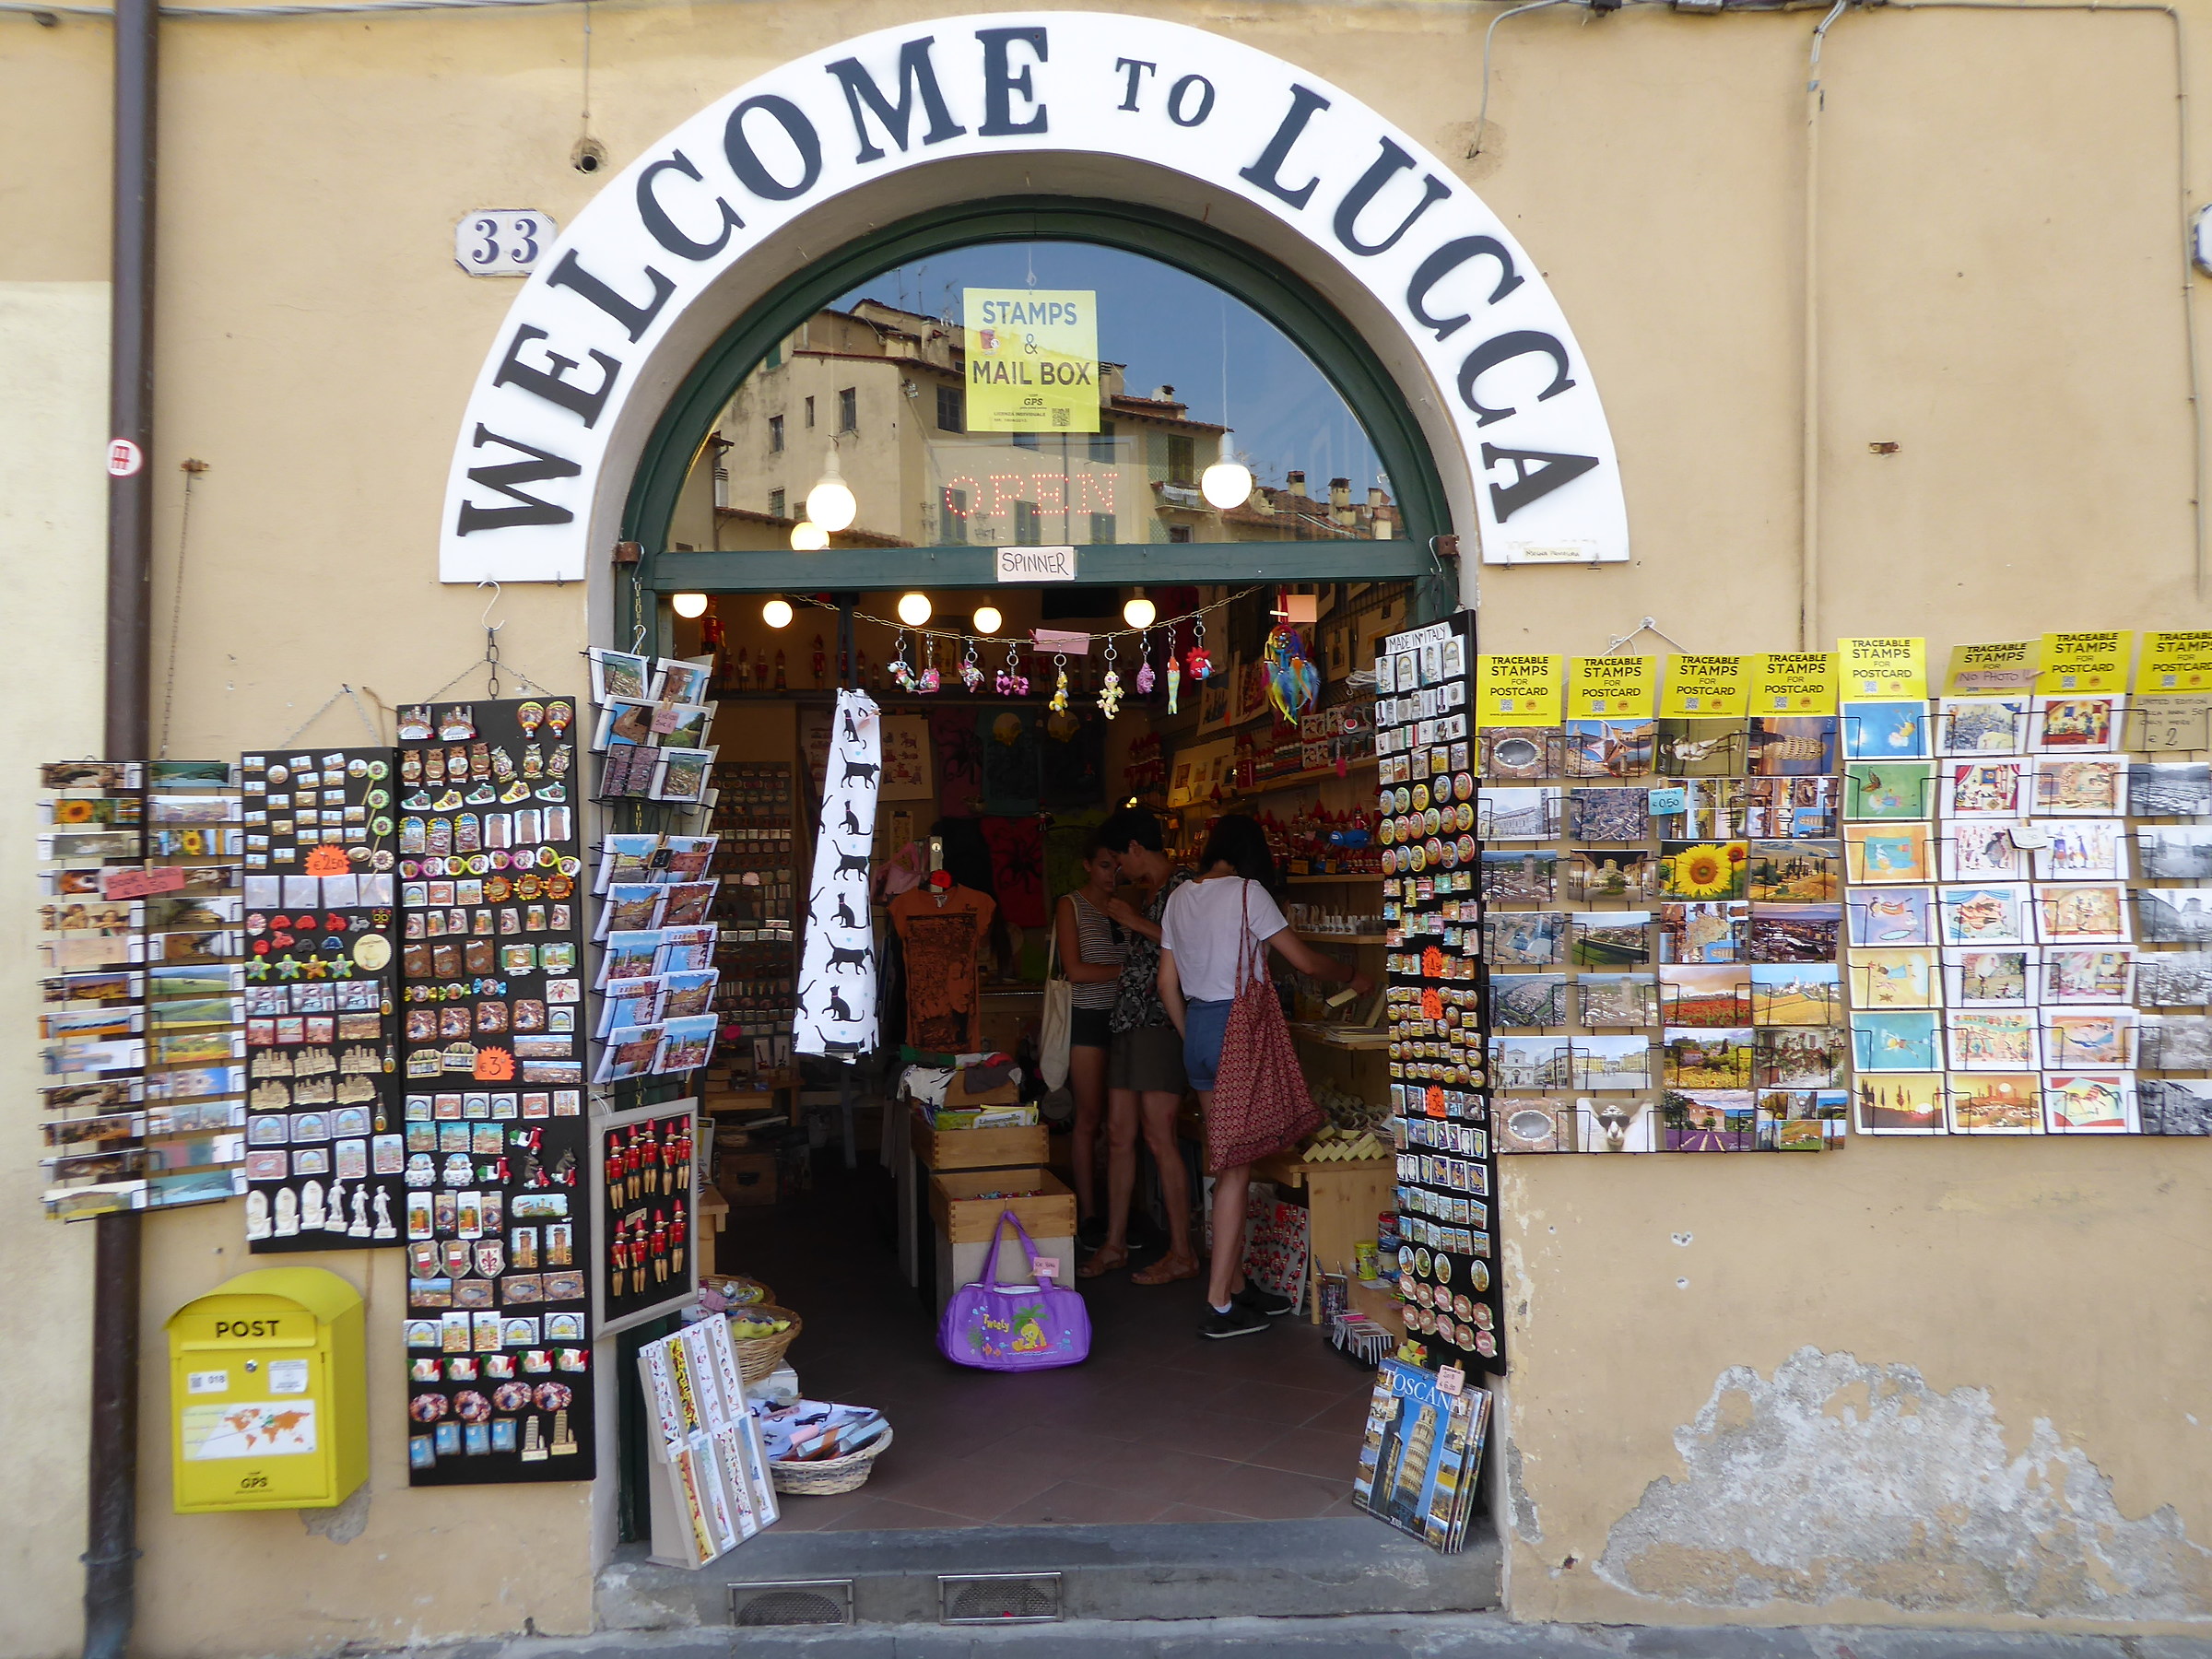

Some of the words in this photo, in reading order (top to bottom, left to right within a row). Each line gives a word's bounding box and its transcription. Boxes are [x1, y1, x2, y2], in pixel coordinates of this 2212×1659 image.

[472, 218, 538, 265] 33
[457, 26, 1048, 537] WELCOME
[1115, 57, 1215, 127] TO
[1239, 82, 1599, 524] LUCCA
[982, 300, 1077, 325] STAMPS
[1024, 333, 1039, 355] &
[973, 360, 1032, 385] MAIL
[1041, 362, 1091, 385] BOX
[1023, 397, 1043, 406] GPS
[946, 472, 1119, 517] OPEN
[1002, 551, 1069, 576] SPINNER
[1389, 635, 1411, 653] MADE
[1412, 632, 1421, 646] IN
[1424, 626, 1446, 643] ITALY
[2056, 632, 2119, 642] TRACEABLE
[2159, 631, 2212, 641] TRACEABL
[1852, 640, 1911, 648] TRACEABLE
[1967, 642, 2028, 653] TRACEABLE
[2055, 641, 2117, 653] STAMPS
[1769, 654, 1827, 663] TRACEABLE
[1853, 648, 1911, 659] STAMPS
[1964, 651, 2025, 664] STAMPS
[1491, 656, 1548, 665] TRACEABLE
[1584, 657, 1642, 665] TRACEABLE
[1681, 655, 1740, 665] TRACEABLE
[1491, 665, 1548, 677] STAMPS
[1583, 666, 1641, 677] STAMPS
[1679, 665, 1738, 677] STAMPS
[1767, 663, 1826, 674] STAMPS
[1853, 669, 1912, 678] POSTCARD
[2053, 664, 2114, 673] POSTCARD
[1490, 687, 1548, 696] POSTCARD
[1583, 688, 1641, 697] POSTCARD
[1677, 686, 1735, 695] POSTCARD
[1764, 685, 1824, 694] POSTCARD
[2165, 727, 2178, 746] 2
[488, 1056, 501, 1076] 3
[216, 1319, 280, 1338] POST
[1384, 1367, 1464, 1417] TOSCANA
[240, 1477, 267, 1488] GPS
